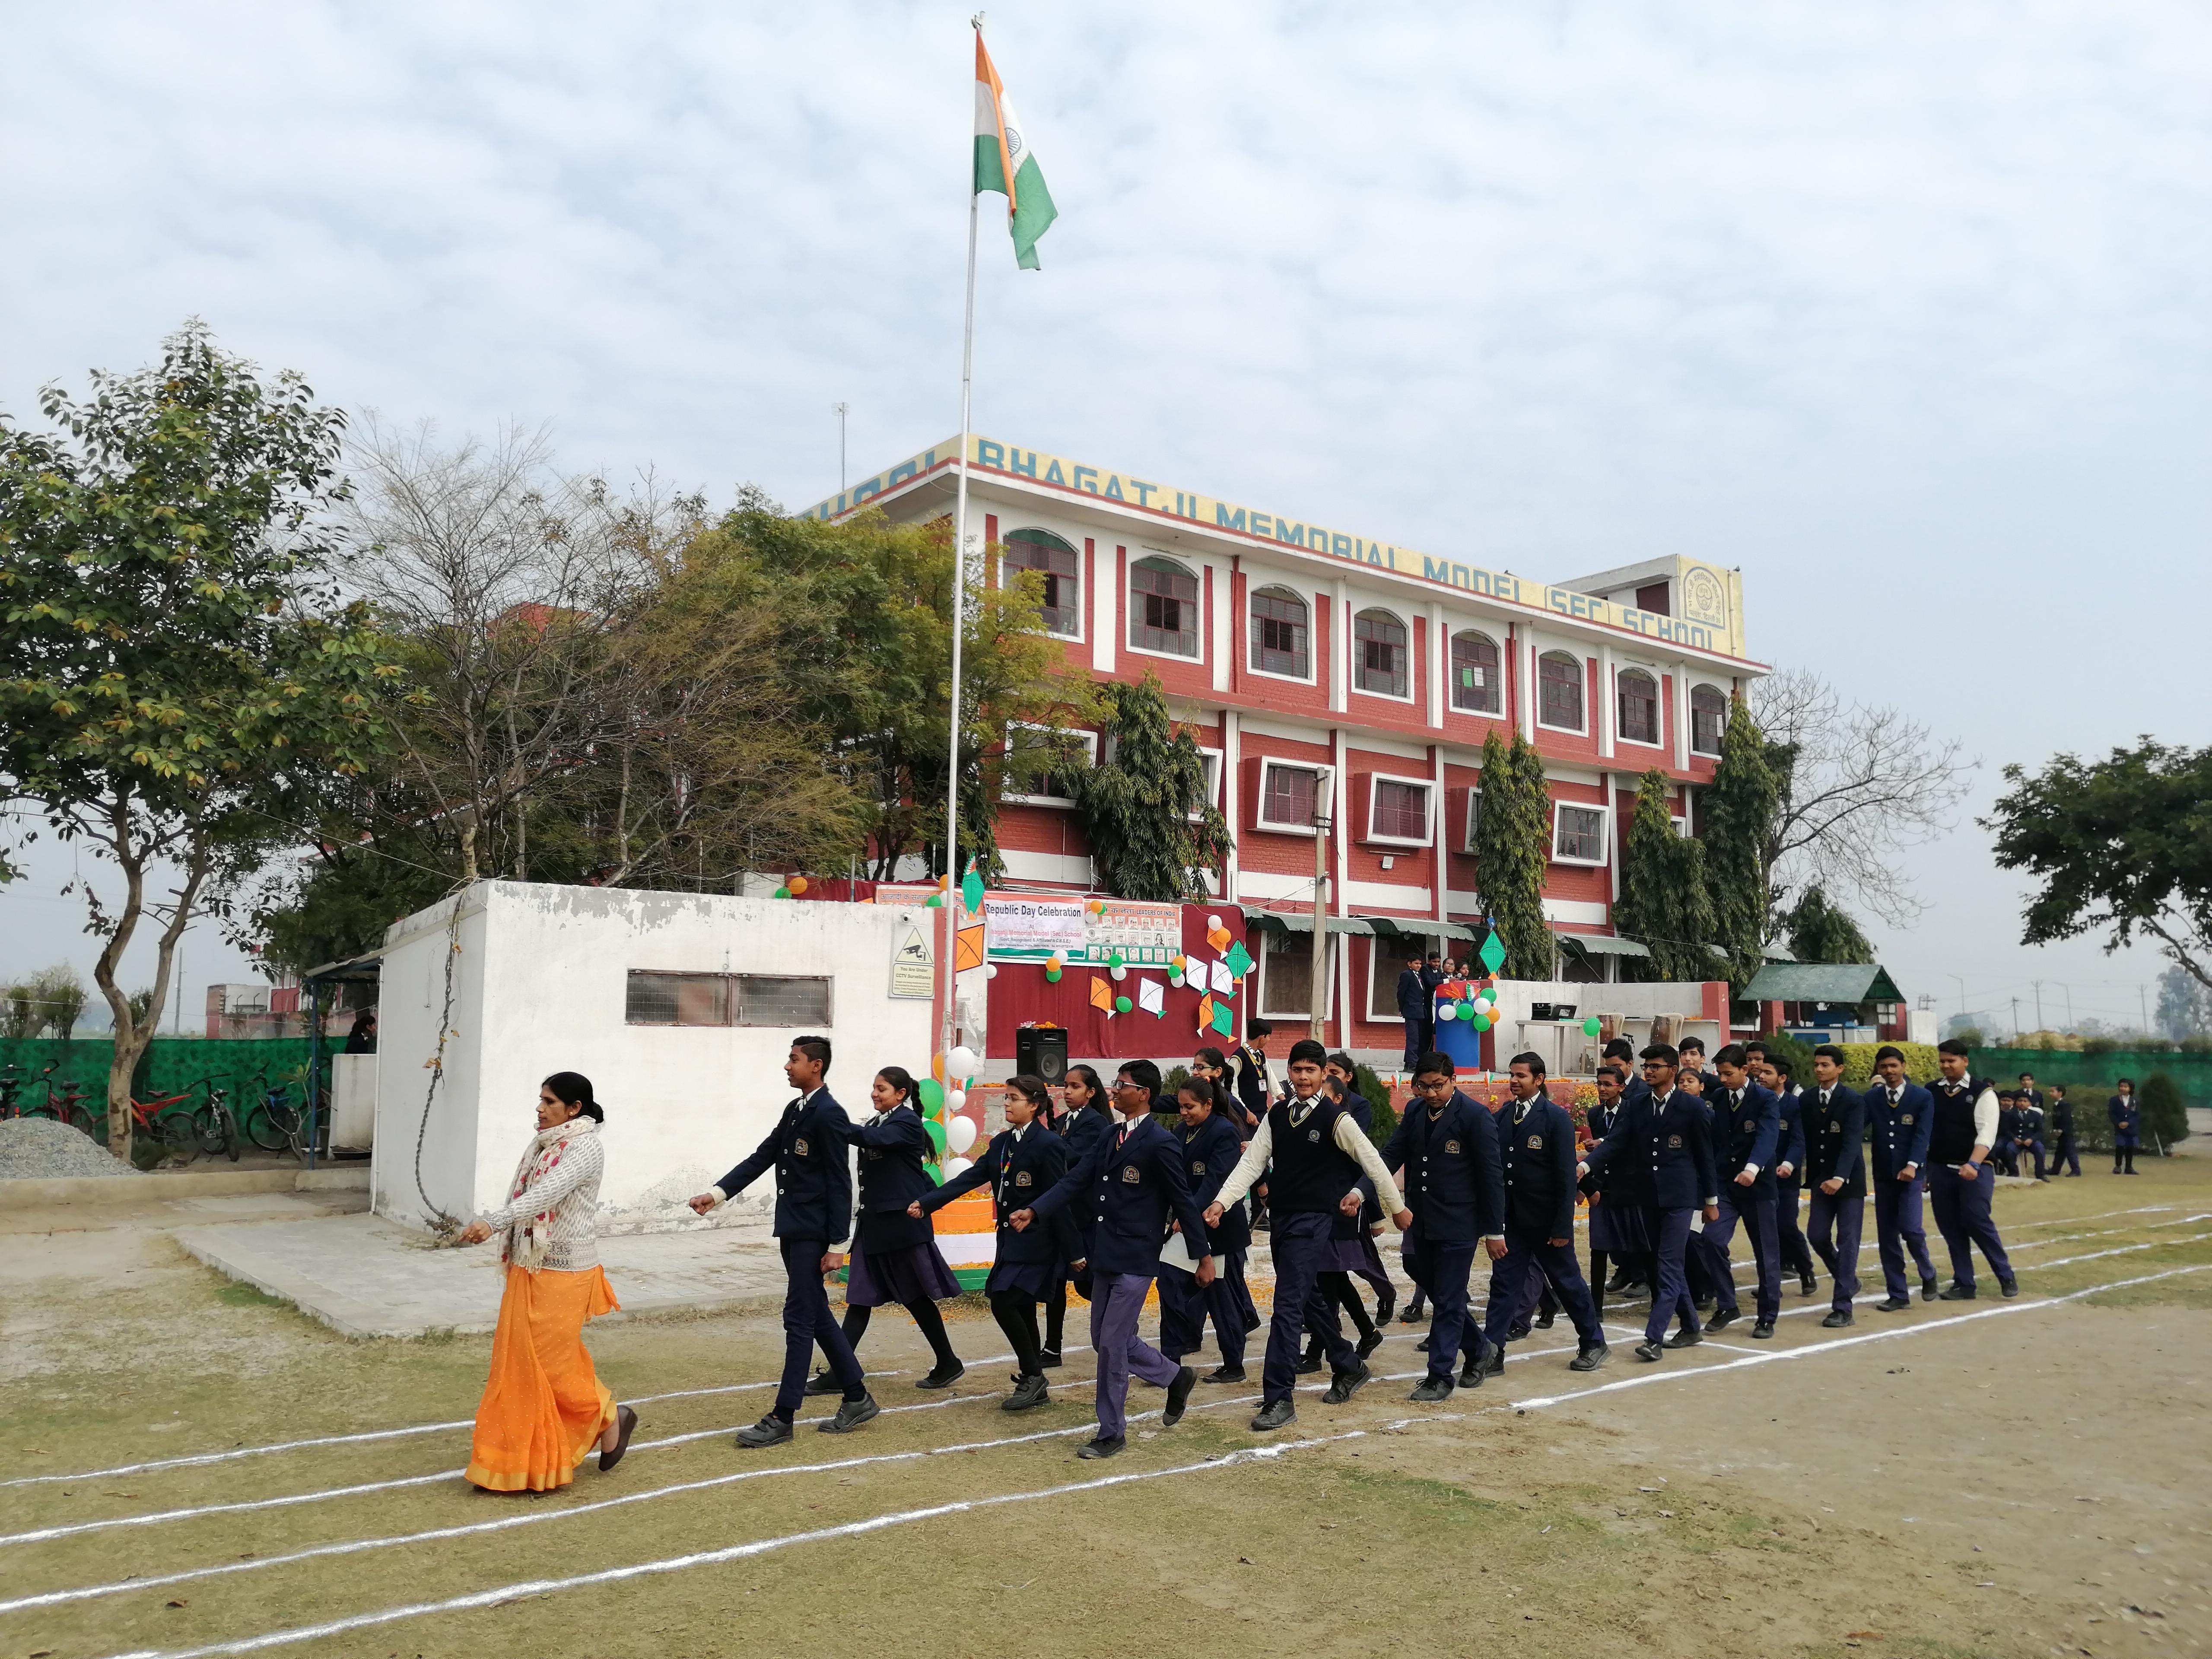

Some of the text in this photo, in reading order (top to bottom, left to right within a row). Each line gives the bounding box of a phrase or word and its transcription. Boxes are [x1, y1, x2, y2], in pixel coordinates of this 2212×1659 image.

[985, 904, 1019, 916] Republic
[1021, 905, 1036, 918] Day
[1038, 906, 1081, 917] Celebration
